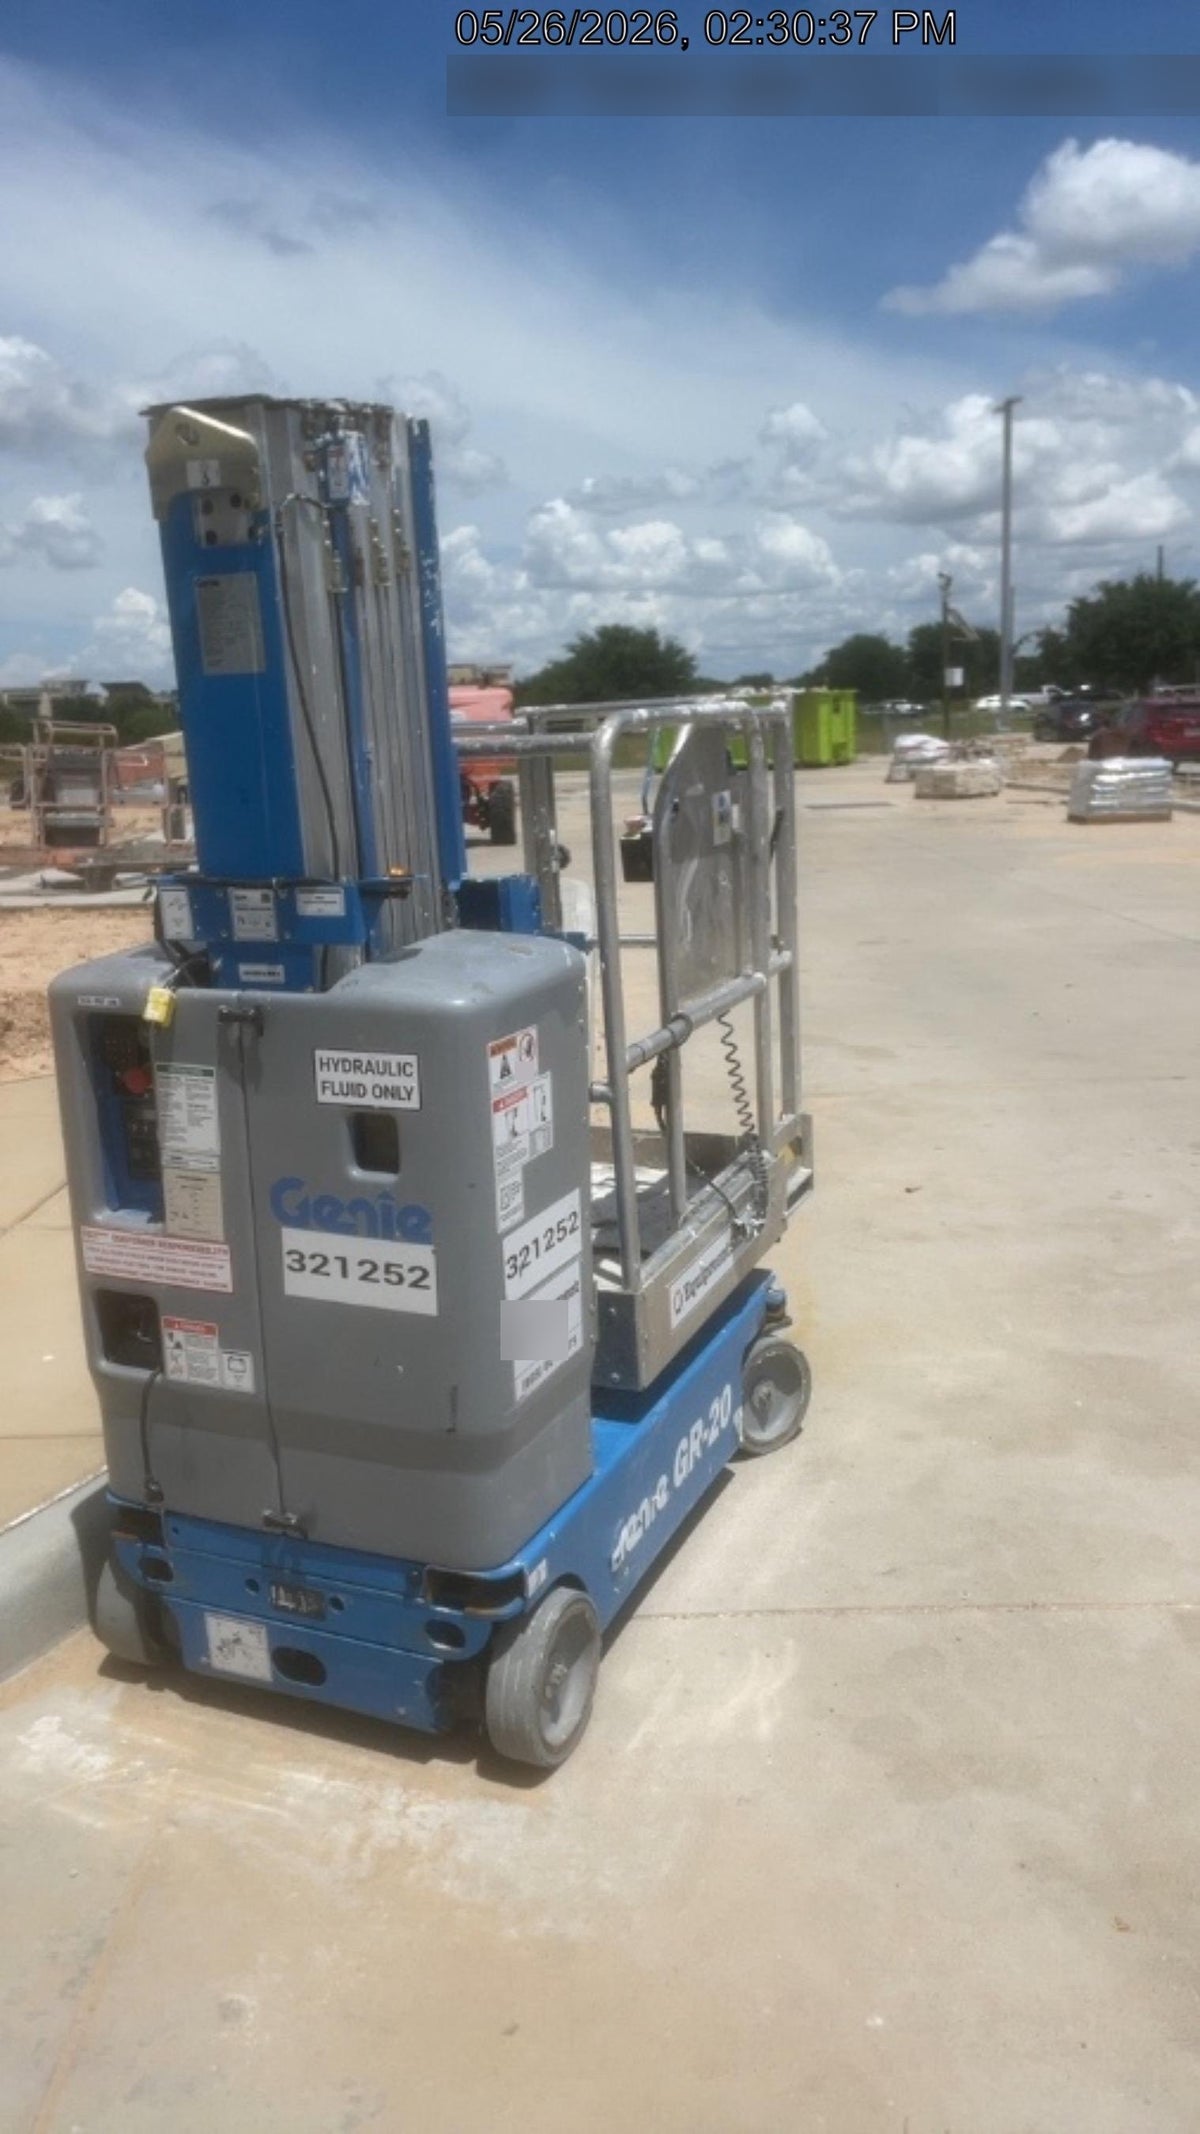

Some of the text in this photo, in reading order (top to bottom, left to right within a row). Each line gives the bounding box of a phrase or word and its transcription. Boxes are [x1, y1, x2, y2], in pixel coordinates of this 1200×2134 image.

[319, 1057, 414, 1077] HYDRAULIC
[321, 1081, 415, 1101] FLUID ONLY
[270, 1176, 433, 1245] Genie
[285, 1249, 431, 1290] 321252
[505, 1211, 580, 1280] 321252
[673, 1384, 732, 1488] GR-20
